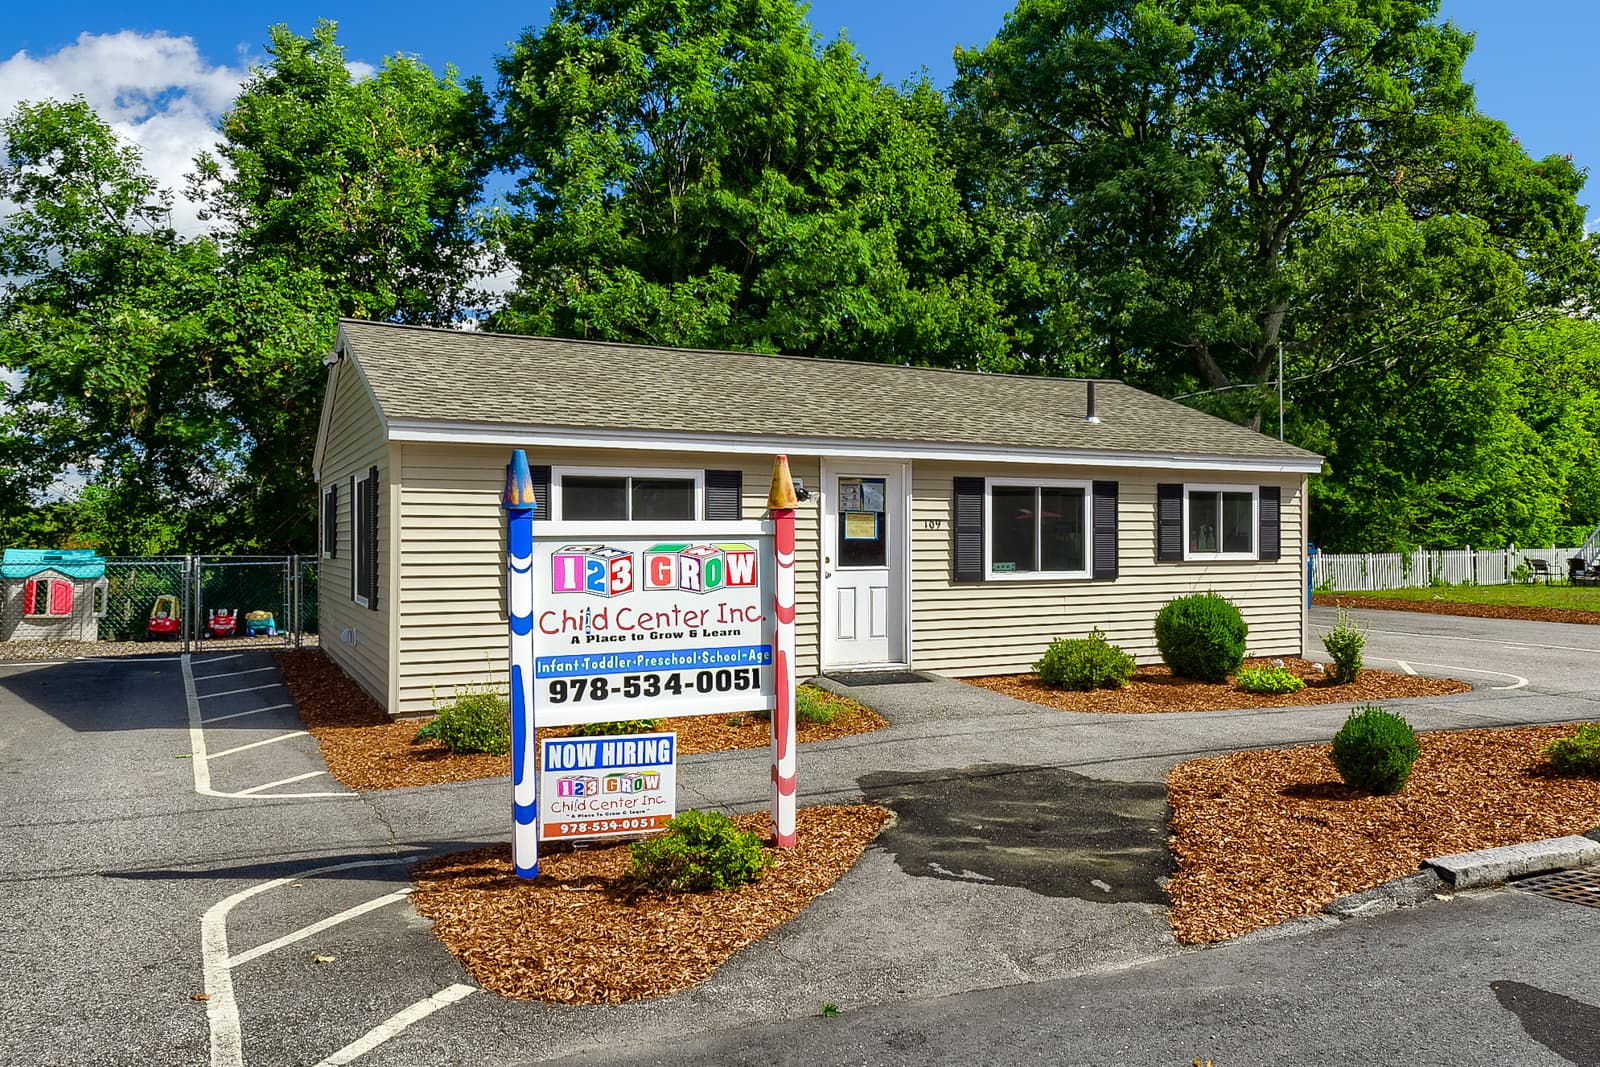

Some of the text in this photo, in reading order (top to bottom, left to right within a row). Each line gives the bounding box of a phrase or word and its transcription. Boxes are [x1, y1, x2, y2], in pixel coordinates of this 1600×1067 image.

[561, 553, 756, 593] 123 GROW
[538, 602, 767, 635] Child Center Inc.
[571, 628, 741, 645] A Place to Grow & Learn
[548, 667, 761, 704] 978-534-0051
[548, 739, 670, 769] NOW HIRING
[560, 775, 659, 796] 123 GROW
[550, 799, 586, 814] Child
[589, 796, 639, 811] Center
[560, 818, 655, 834] 978-534-0051
